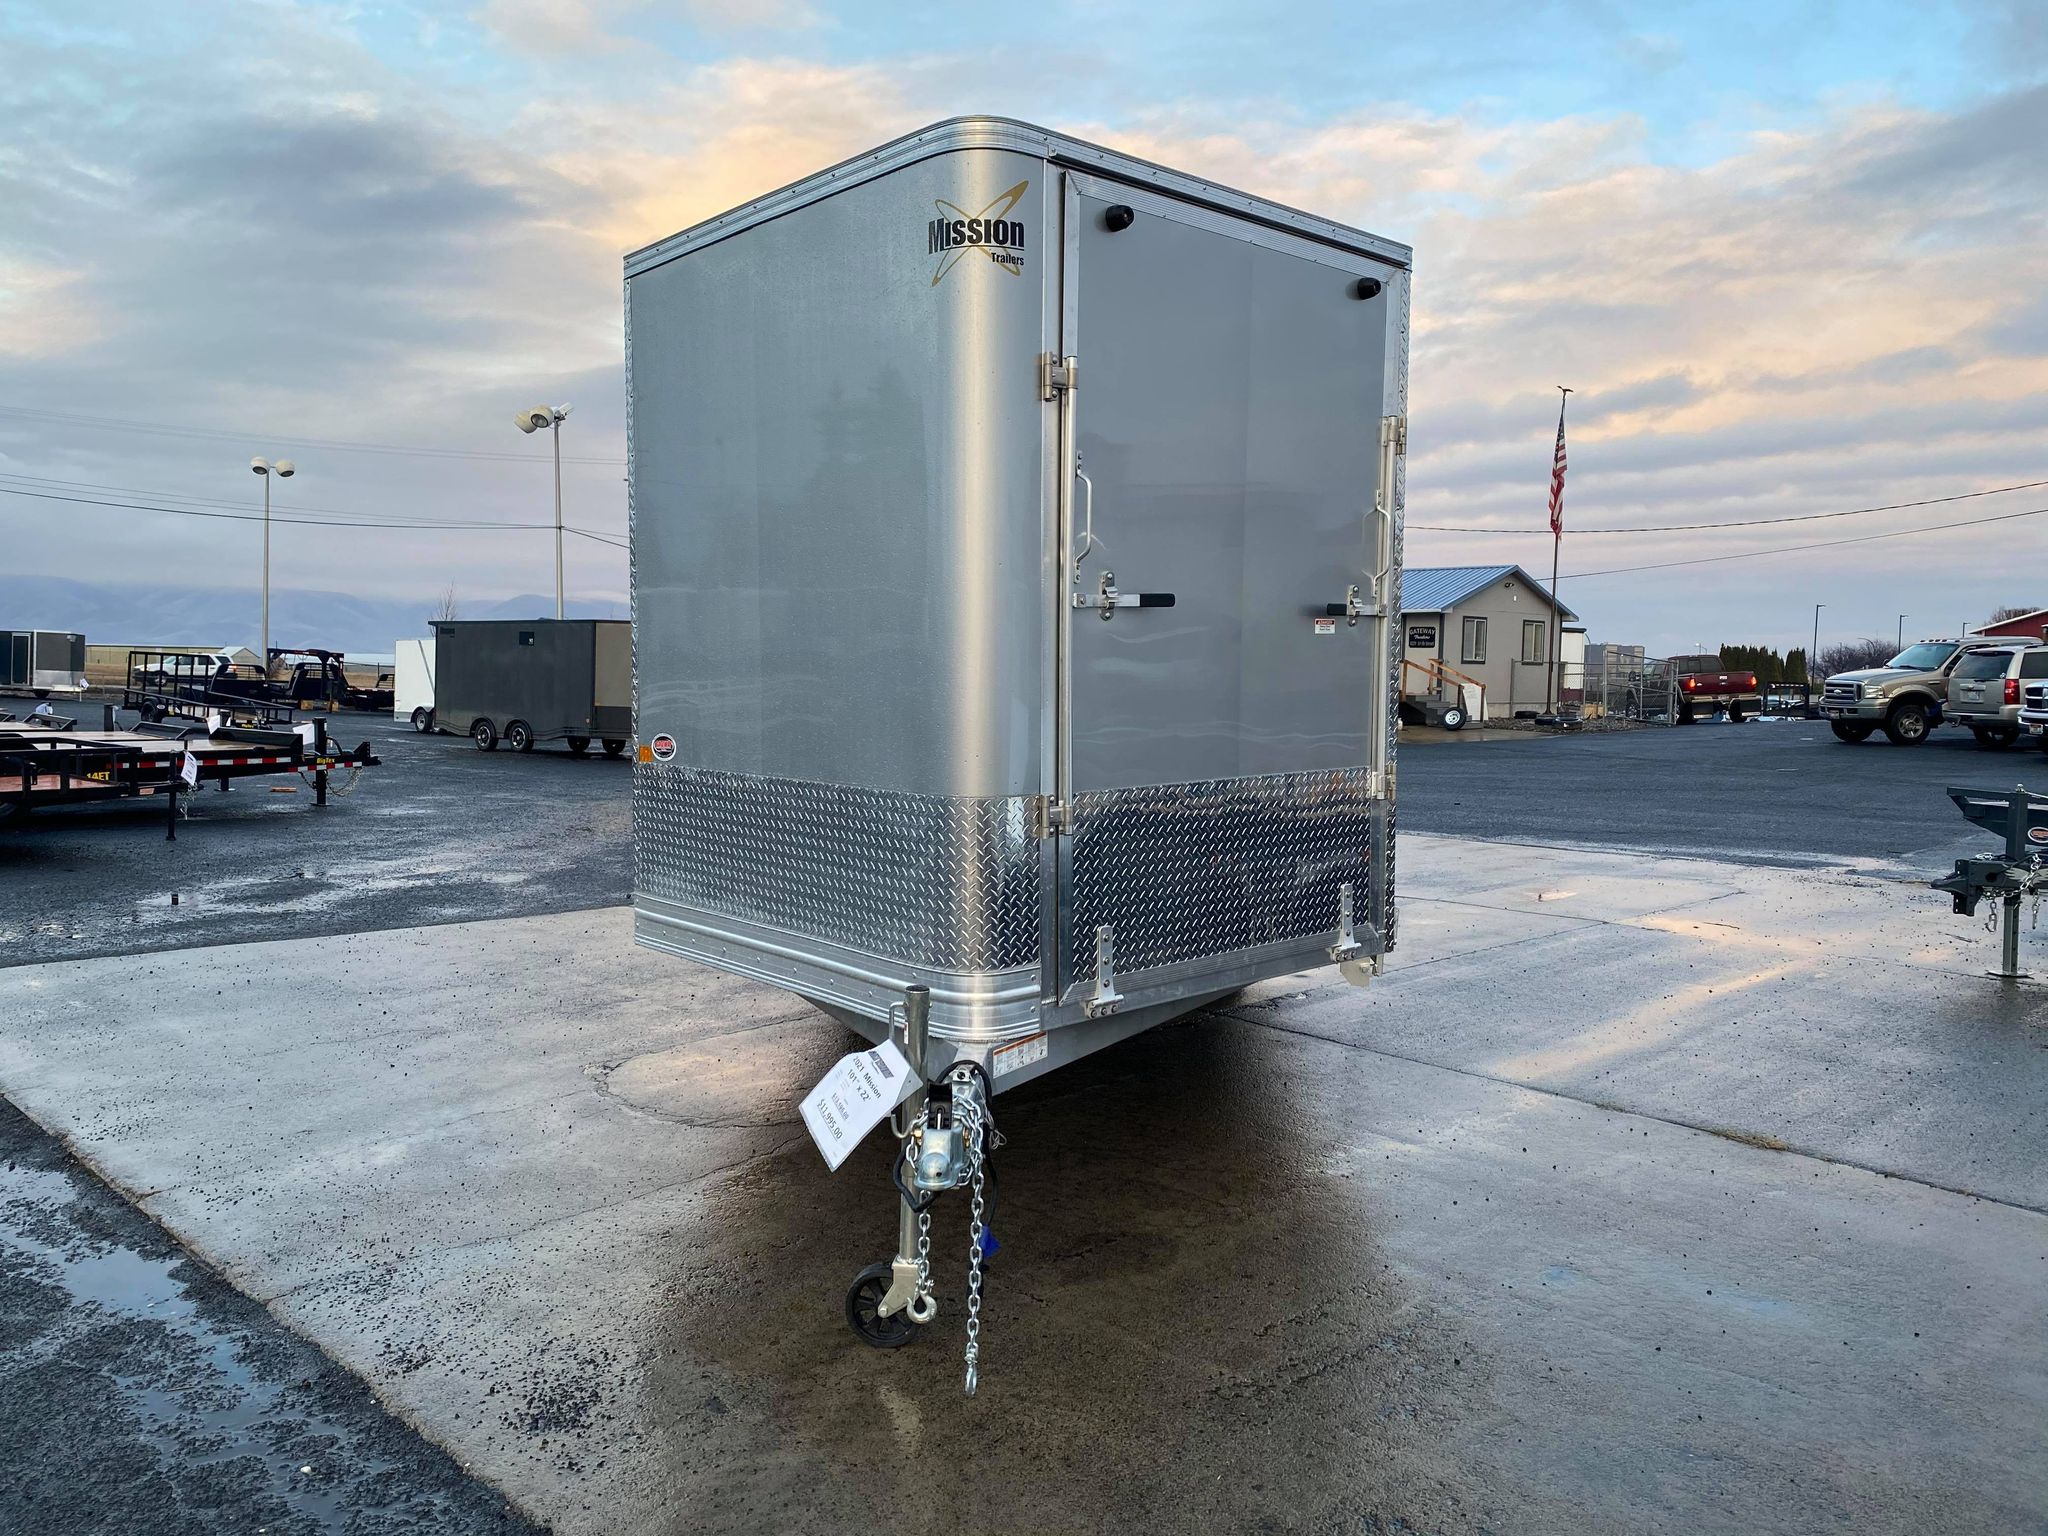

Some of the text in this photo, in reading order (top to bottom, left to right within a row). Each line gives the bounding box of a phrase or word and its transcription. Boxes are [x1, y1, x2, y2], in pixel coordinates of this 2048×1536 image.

[991, 252, 1025, 266] Trailers
[853, 1056, 865, 1072] 2021
[863, 1072, 882, 1099] Mission
[816, 1098, 843, 1140] $11,995.00
